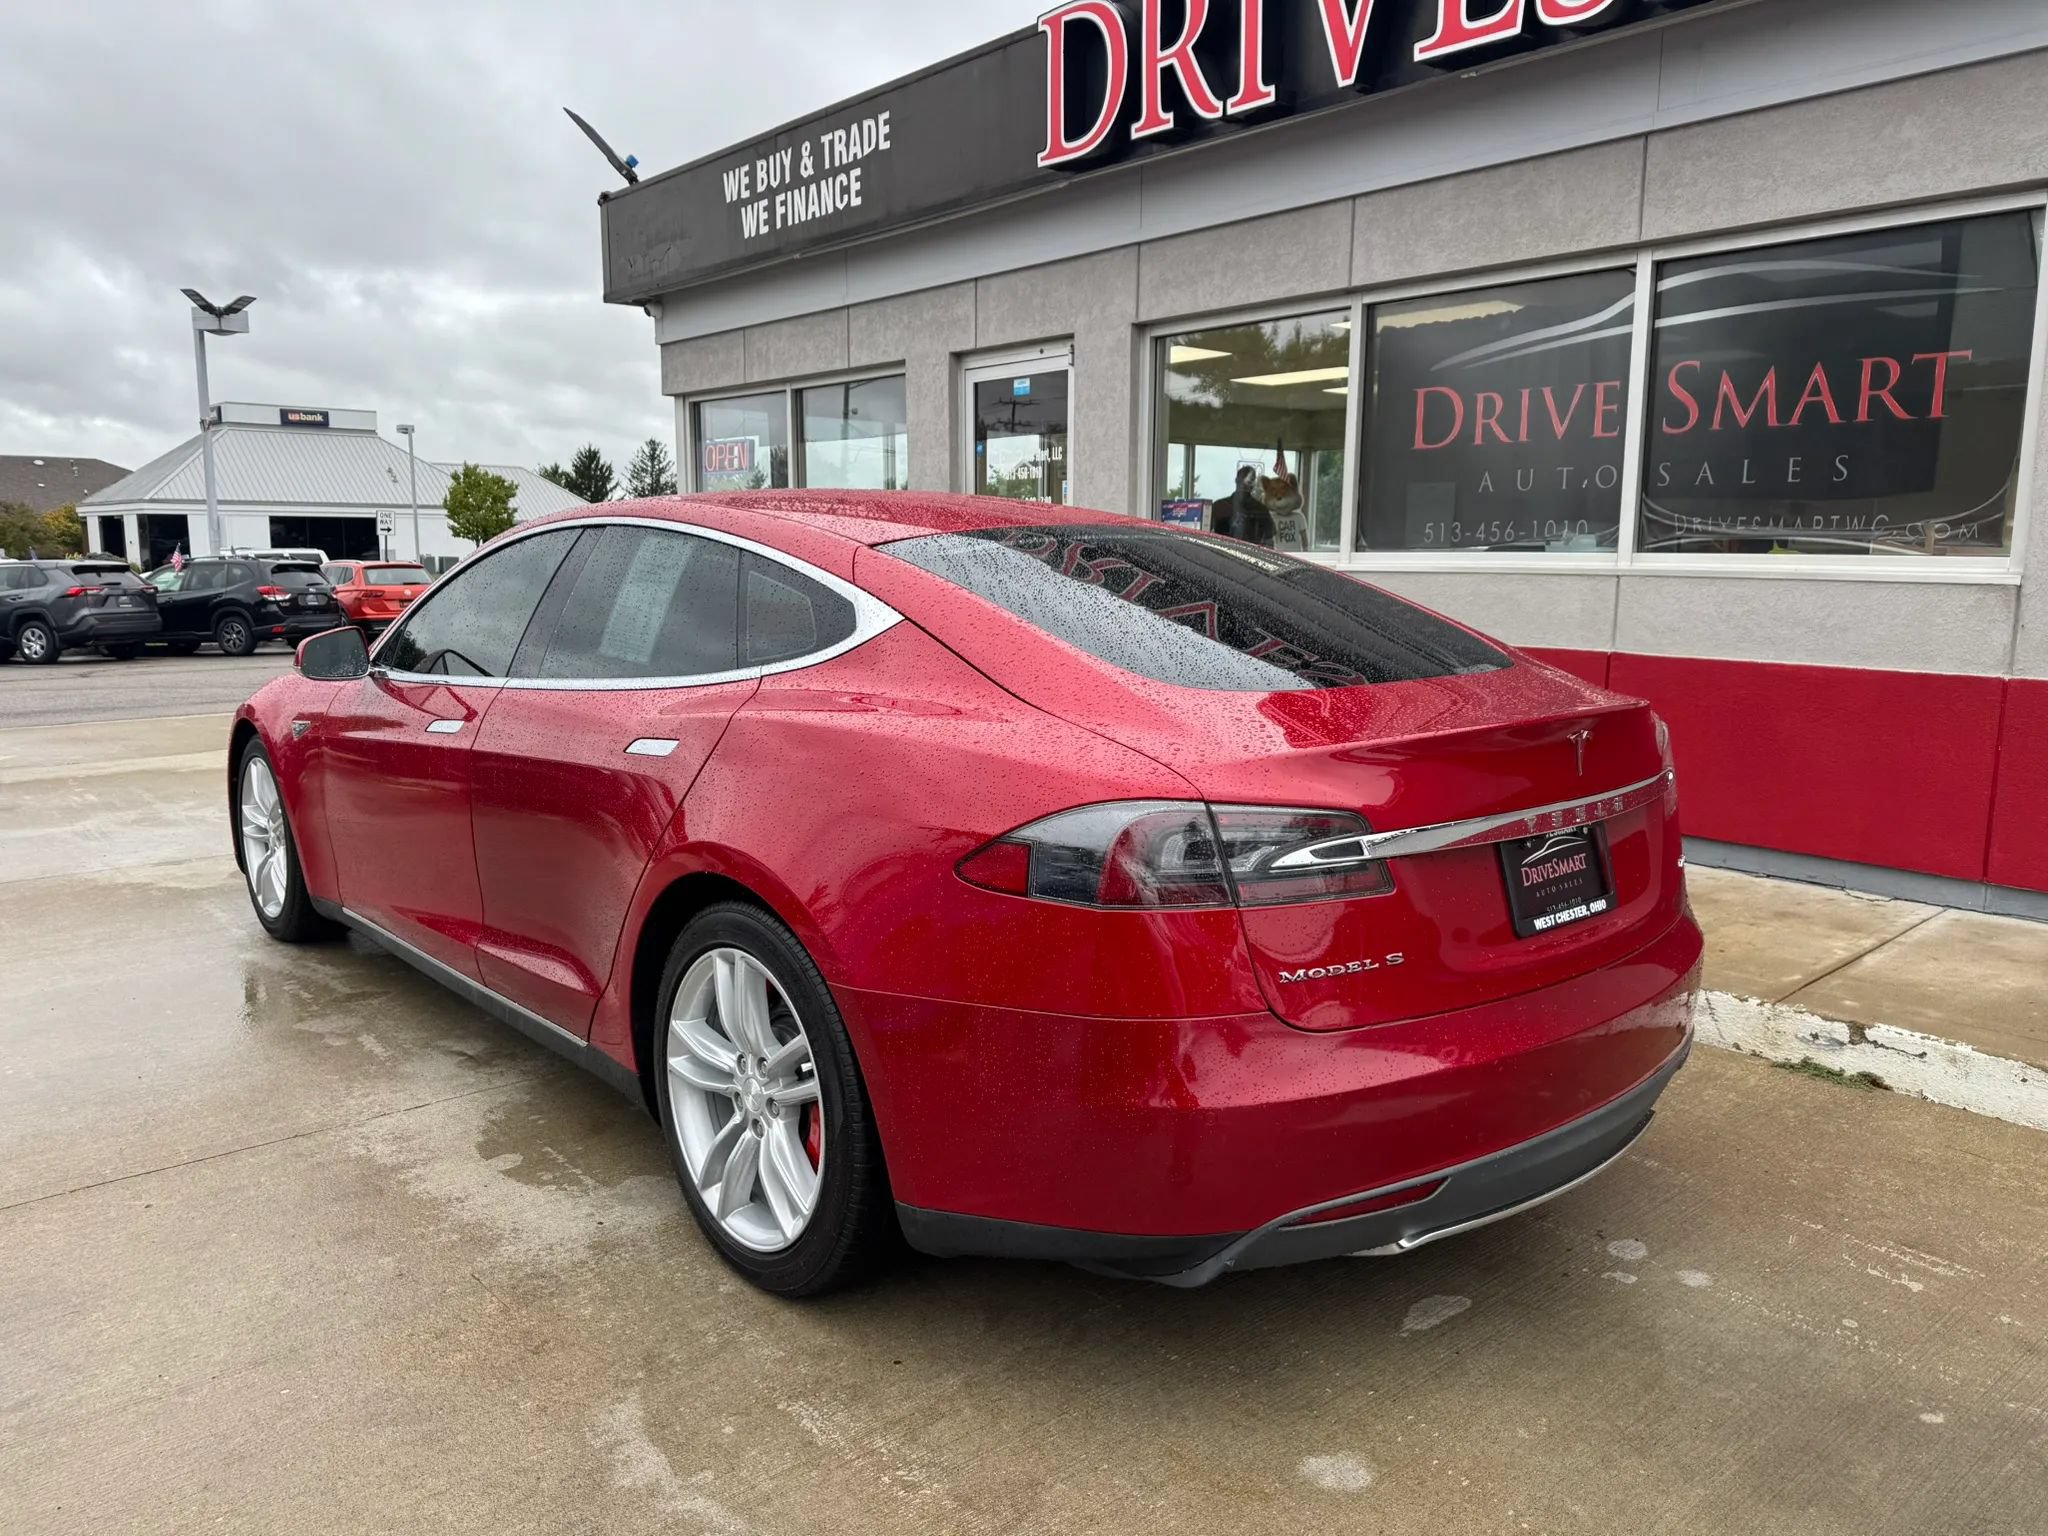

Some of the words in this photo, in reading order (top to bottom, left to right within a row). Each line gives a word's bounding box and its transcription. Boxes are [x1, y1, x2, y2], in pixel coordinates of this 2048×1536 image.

[1037, 0, 1614, 168] DRIV
[723, 165, 750, 203] WE
[756, 148, 792, 193] BUY
[800, 141, 814, 178] &
[821, 110, 891, 170] TRADE
[741, 198, 769, 239] WE
[776, 168, 861, 230] FINANCE
[1412, 380, 1622, 450] DRIVE
[1662, 349, 1973, 435] SMART
[706, 443, 747, 471] OPEN
[1052, 446, 1063, 460] LLC
[1478, 464, 1618, 493] AUTO
[1657, 455, 1849, 487] SALES
[1278, 520, 1295, 531] CAR
[1279, 532, 1296, 543] FOX
[1424, 520, 1588, 543] 513-456-1010
[1536, 886, 1556, 897] AUTO
[1534, 914, 1555, 931] WEST
[1556, 905, 1590, 924] CHESTER,
[1590, 899, 1607, 913] OHIO
[1279, 959, 1379, 983] MODEL
[1385, 952, 1405, 965] S
